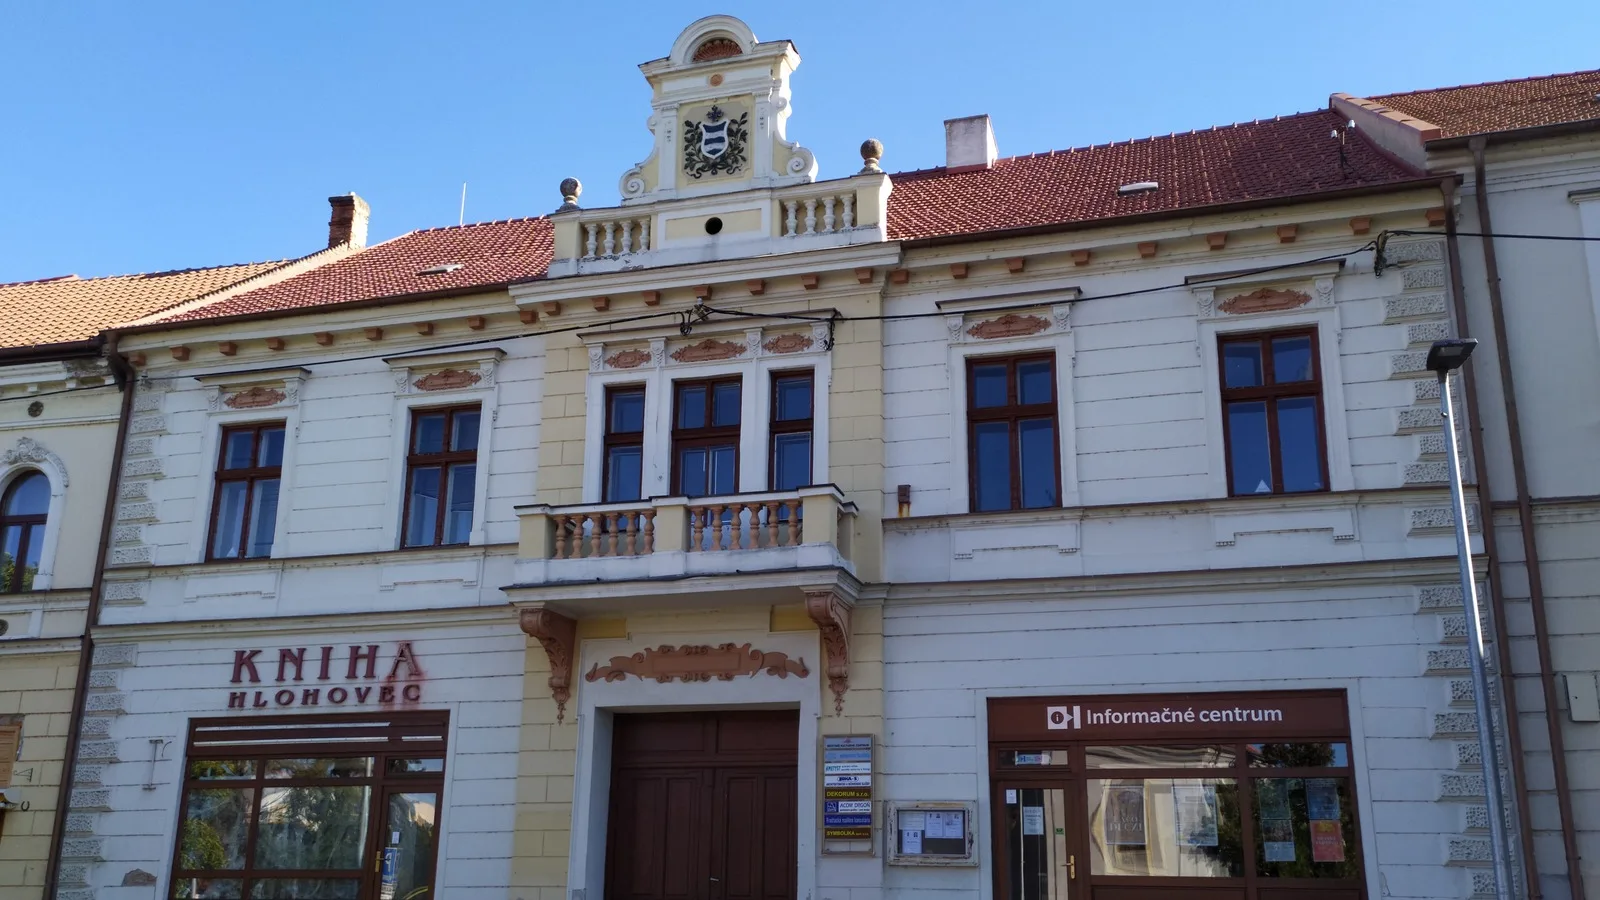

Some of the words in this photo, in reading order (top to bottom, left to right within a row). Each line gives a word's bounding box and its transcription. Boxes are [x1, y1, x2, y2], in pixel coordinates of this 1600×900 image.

[230, 640, 421, 683] KNIHA
[228, 684, 421, 708] HLOHOVEC
[1087, 707, 1195, 724] Informačné
[1199, 707, 1283, 722] centrum
